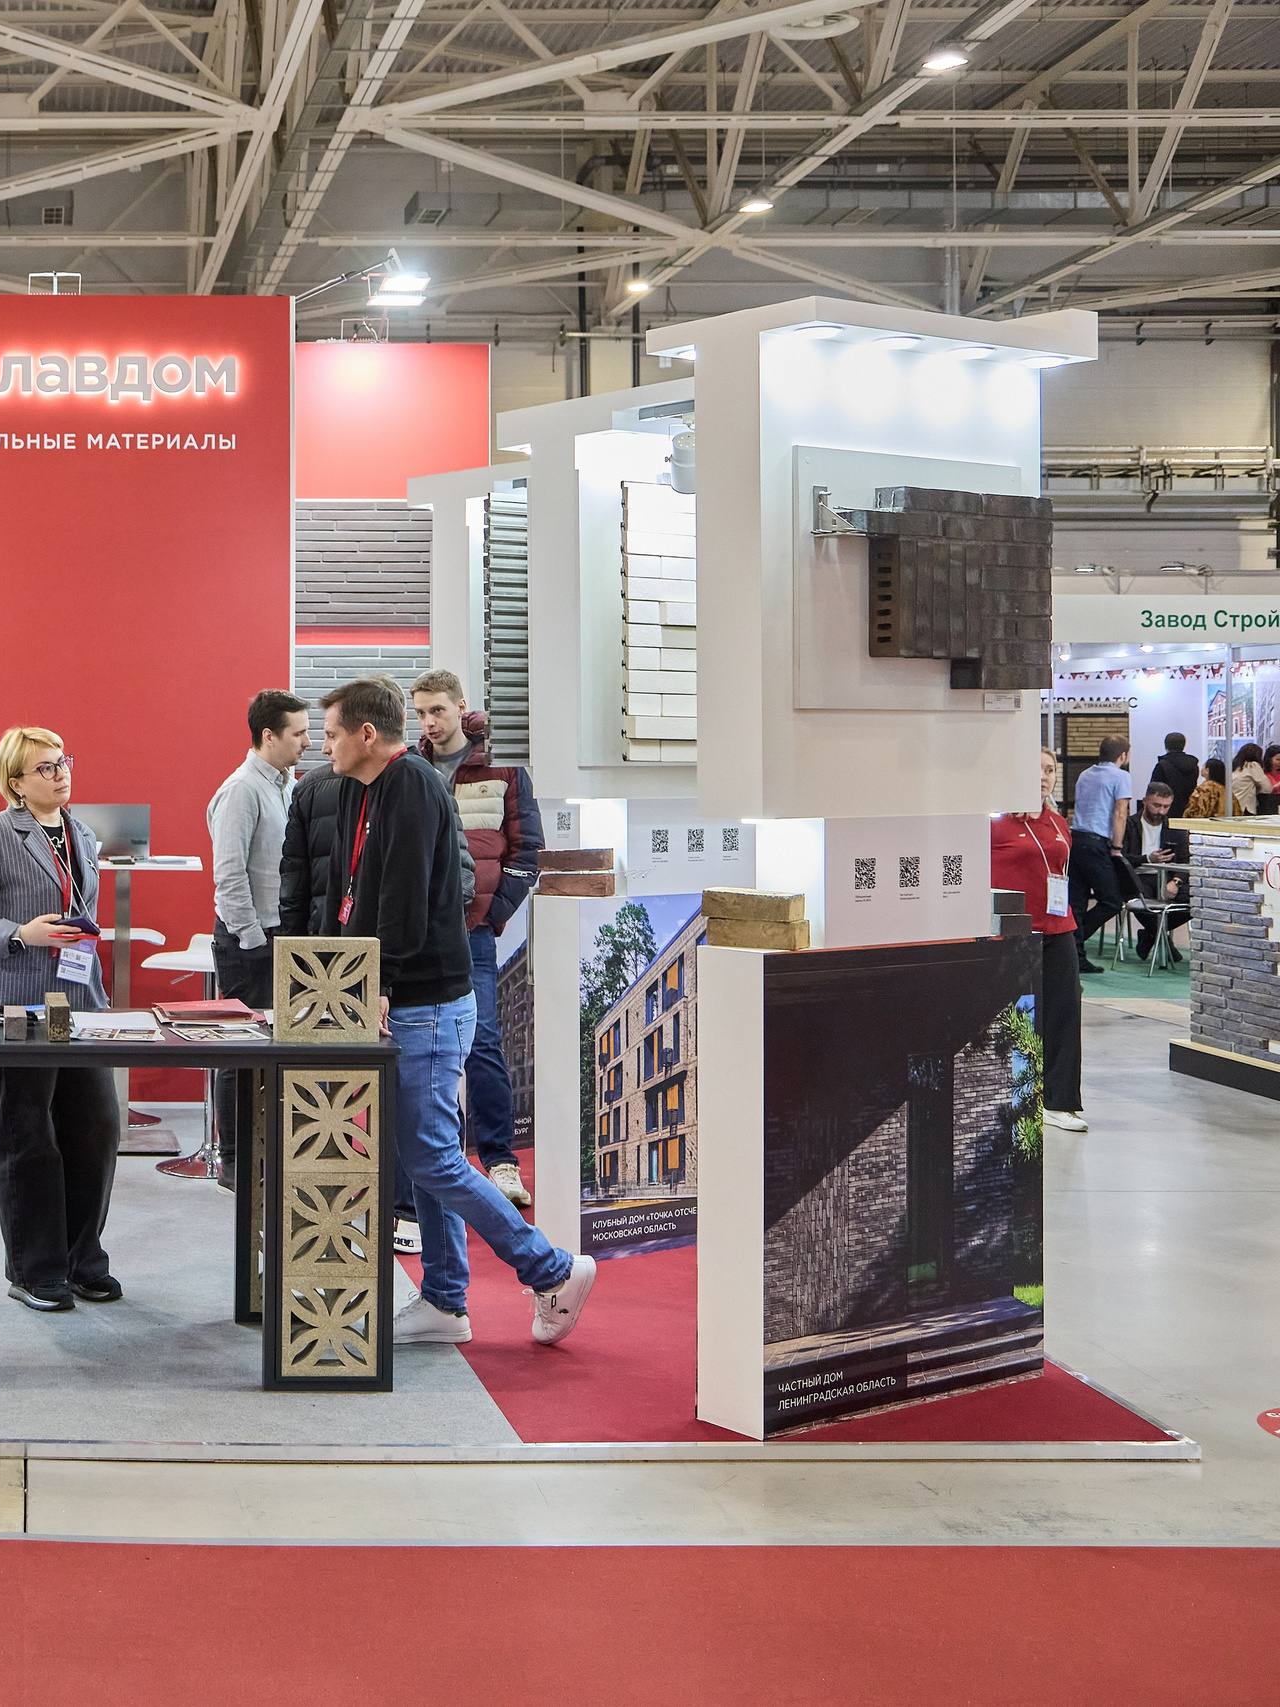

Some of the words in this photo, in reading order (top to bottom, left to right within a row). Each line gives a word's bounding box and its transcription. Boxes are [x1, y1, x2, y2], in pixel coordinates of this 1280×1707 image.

[86, 433, 237, 450] МАТЕРИАЛЫ
[1141, 610, 1207, 630] Завод
[1214, 609, 1280, 632] Строй
[592, 1215, 628, 1229] КЛУБНЫЙ
[628, 1213, 645, 1225] ДОМ
[646, 1210, 673, 1221] «ТОЧКА
[674, 1206, 697, 1218] ОТСЧЕ
[592, 1227, 643, 1242] МОСКОВСКАЯ
[643, 1222, 677, 1234] ОБЛАСТЬ
[777, 1385, 855, 1411] ЛЕНИНГРАДСКАЯ
[856, 1375, 897, 1393] ОБЛАСТЬ
[778, 1373, 821, 1393] ЧАСТНЫЙ
[822, 1370, 844, 1386] ДОМ
